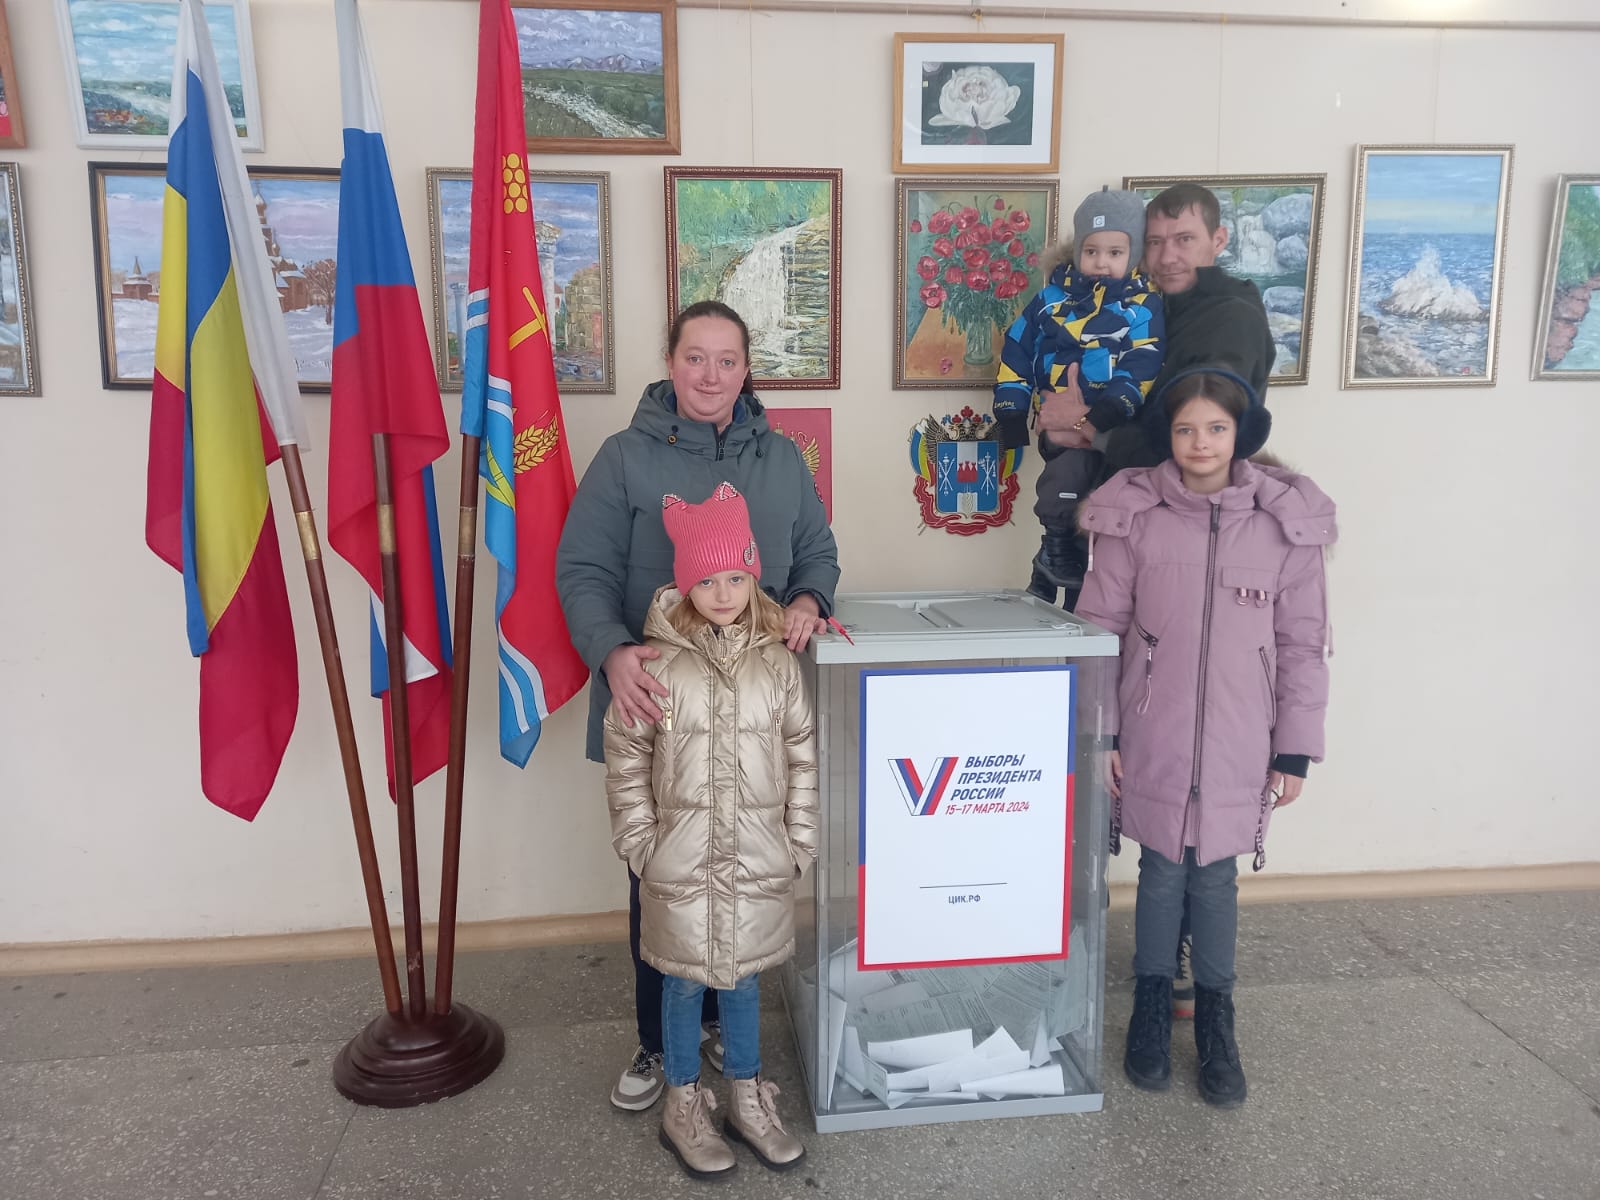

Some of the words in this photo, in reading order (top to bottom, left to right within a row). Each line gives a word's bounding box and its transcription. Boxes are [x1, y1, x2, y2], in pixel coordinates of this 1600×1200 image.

[964, 754, 1026, 769] ВЫБОРЫ
[957, 769, 1043, 785] ПРЕЗИДЕНТА
[950, 787, 1006, 801] РОССИИ
[973, 803, 1006, 814] МАРТА
[1006, 801, 1030, 813] 2024
[948, 894, 981, 905] ЦИК.РФ
